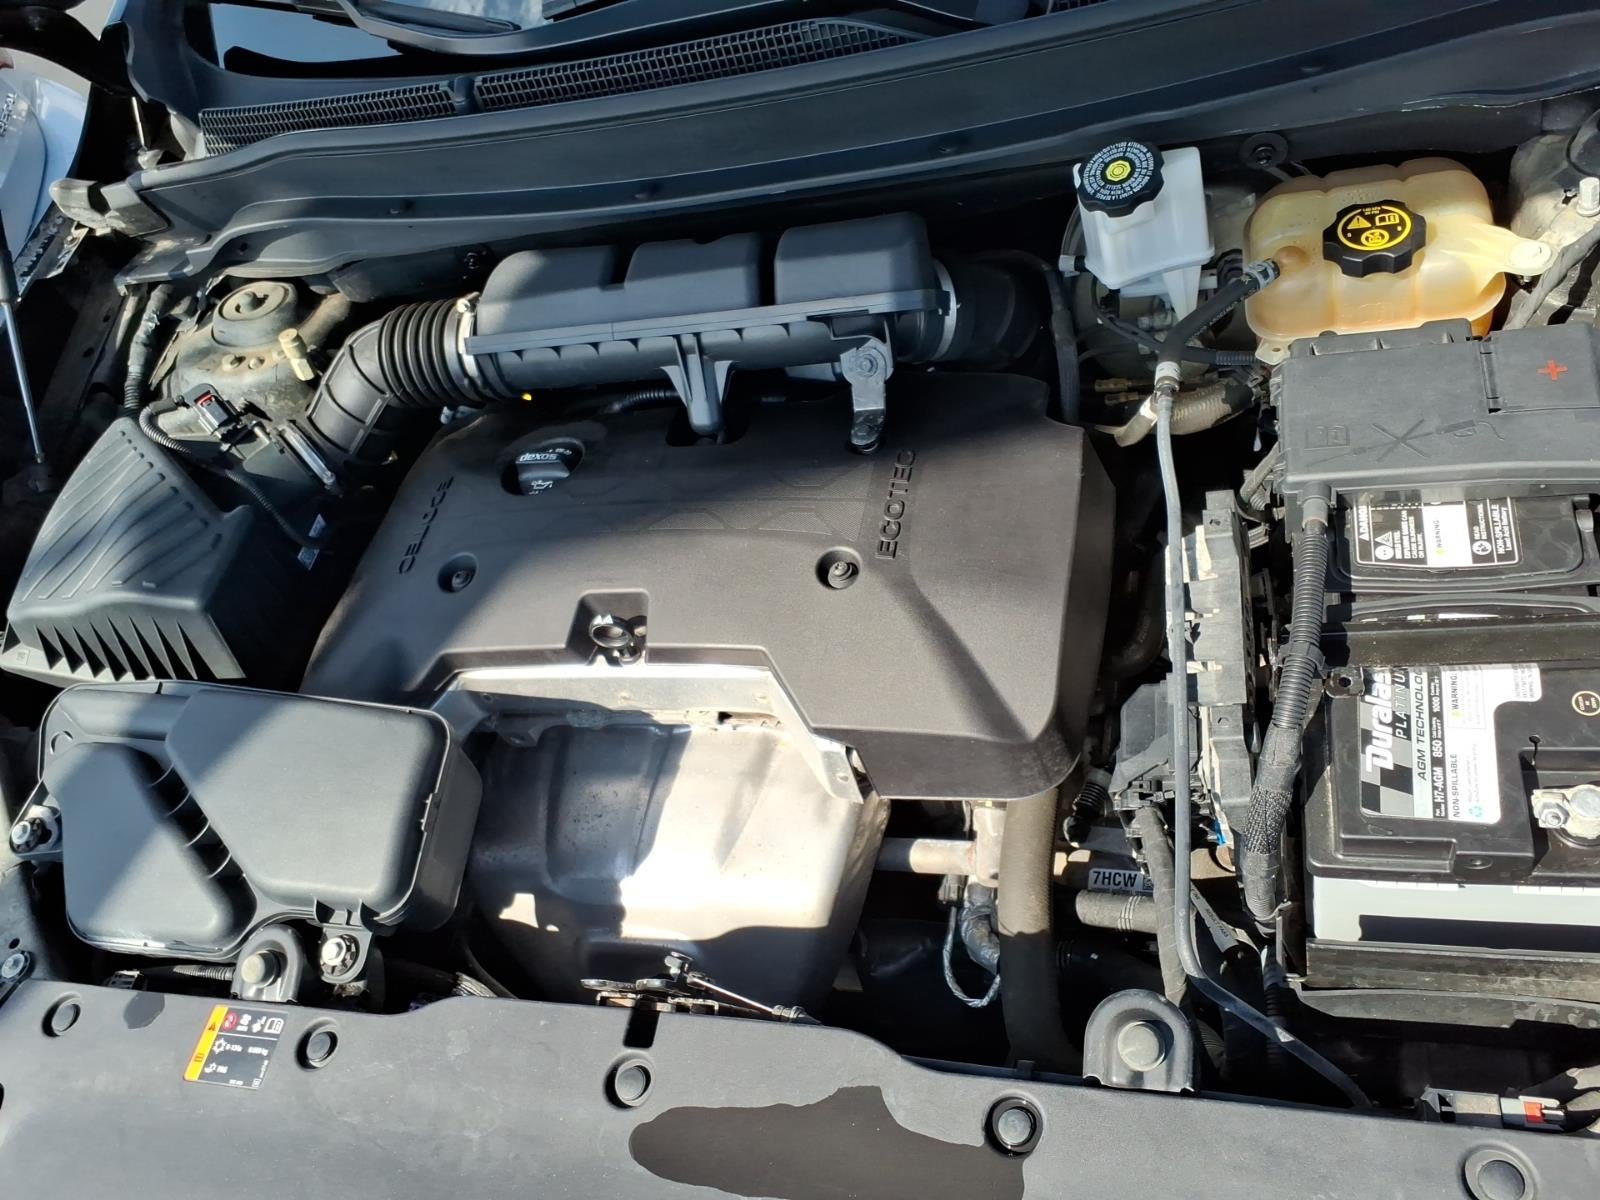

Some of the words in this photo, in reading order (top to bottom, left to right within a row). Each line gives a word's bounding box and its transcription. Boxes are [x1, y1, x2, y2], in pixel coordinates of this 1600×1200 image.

[519, 452, 558, 462] dexos
[874, 449, 916, 560] ECOTEC
[1491, 504, 1505, 554] NON-SPILLABLE
[1394, 670, 1408, 739] PLATINU
[1432, 696, 1440, 712] 1000
[1450, 672, 1460, 710] WARNING:
[1364, 668, 1394, 772] Duralas
[1417, 749, 1426, 782] AGM
[1432, 740, 1443, 758] 850
[1432, 766, 1445, 802] H7-AGM
[1450, 753, 1460, 818] NON-SPILLABLE
[1092, 871, 1138, 888] 7HCW
